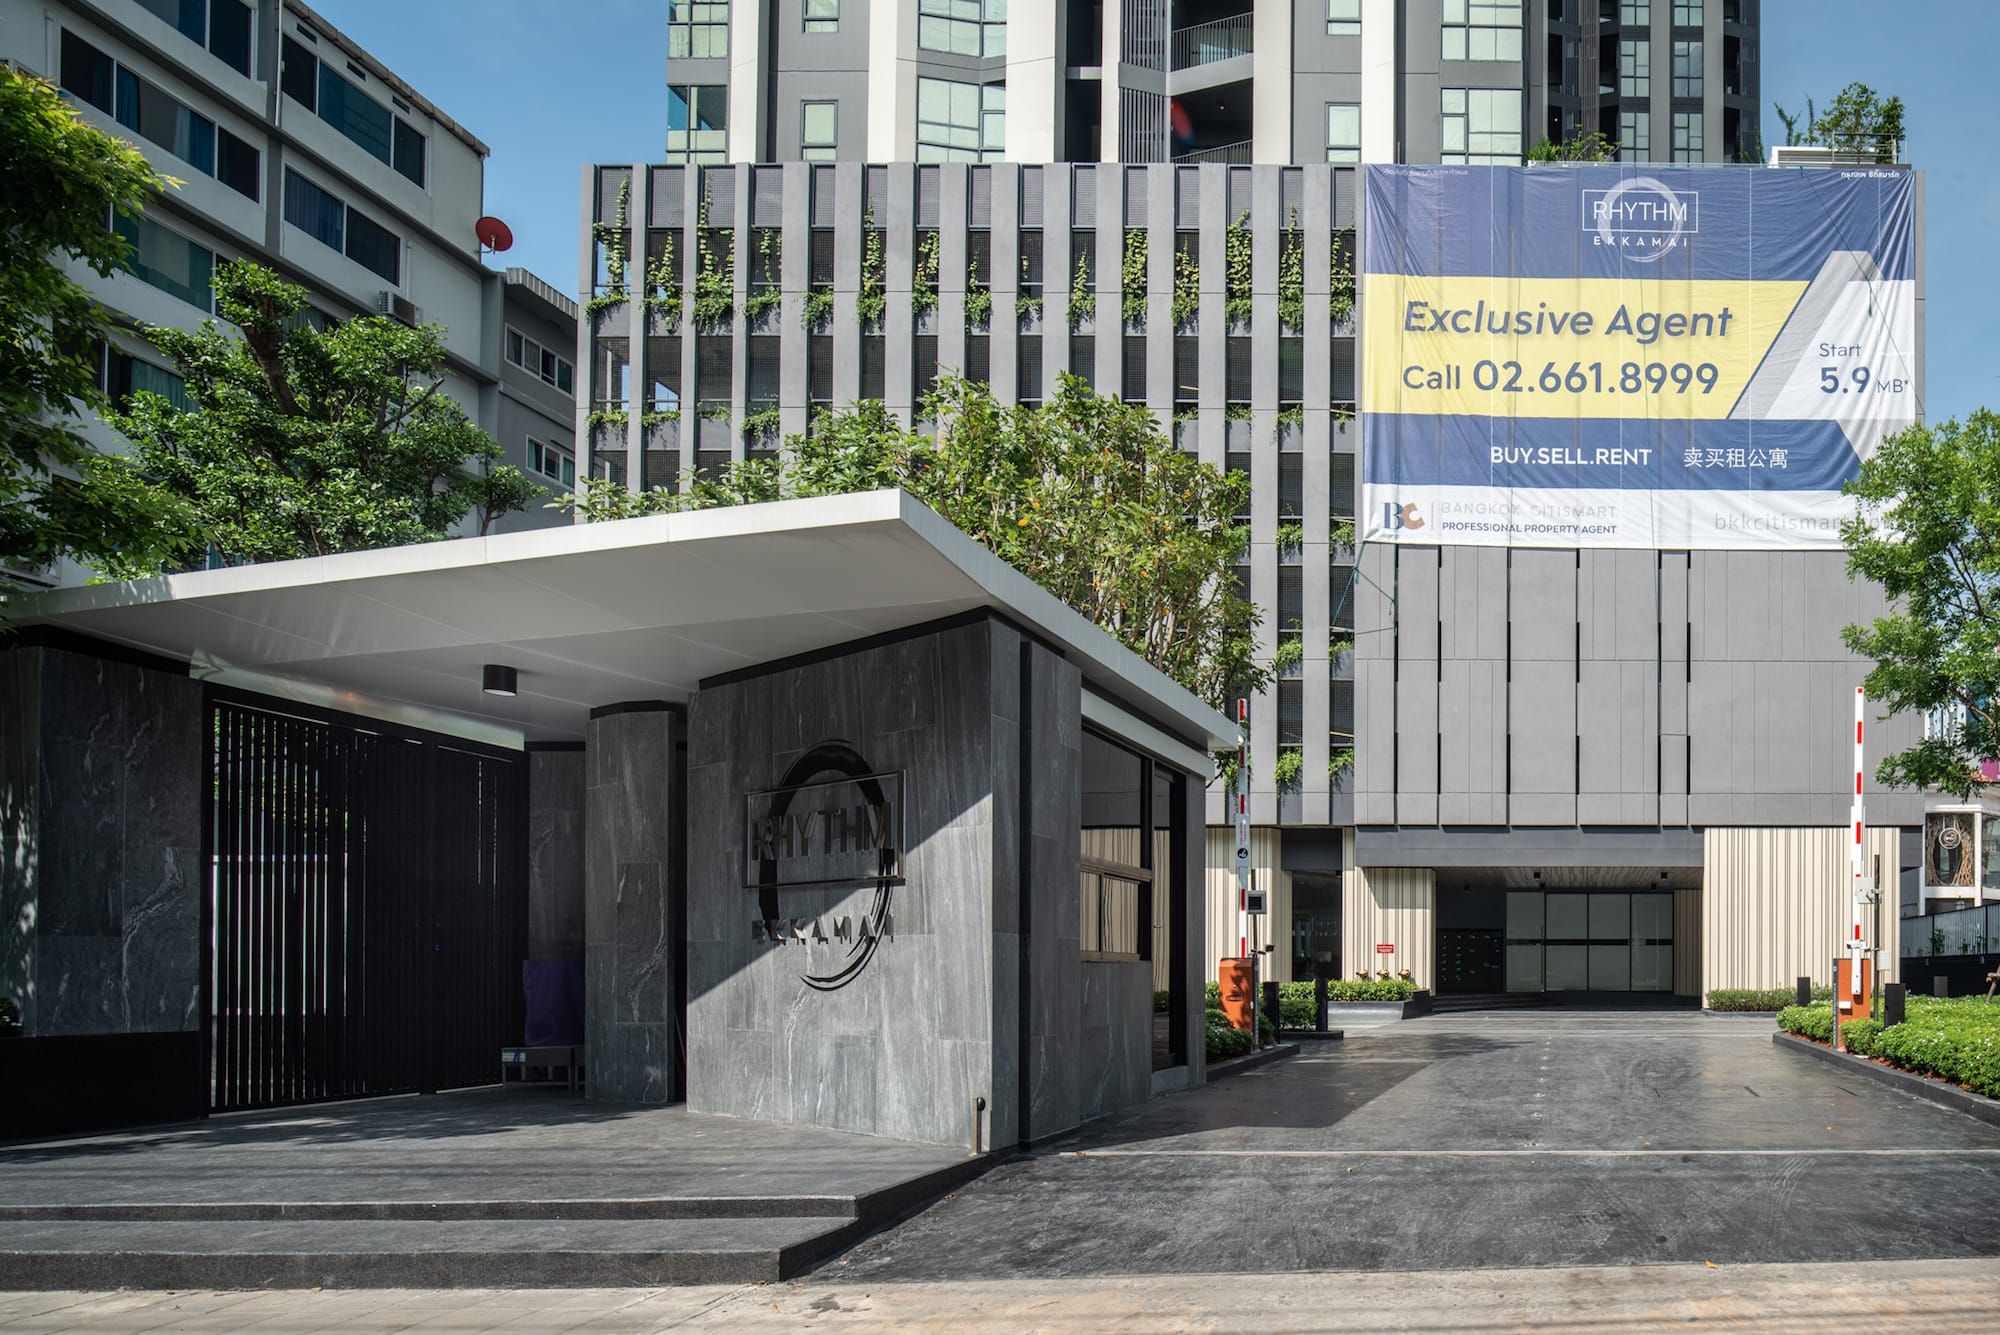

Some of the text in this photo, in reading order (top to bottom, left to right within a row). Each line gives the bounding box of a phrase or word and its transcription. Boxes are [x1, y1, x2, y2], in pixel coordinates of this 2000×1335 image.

[1593, 200, 1687, 221] RHYTHM
[1593, 235, 1687, 248] EKKAMAI
[1404, 300, 1733, 345] Exclusive Agent
[1819, 343, 1862, 357] Start
[1403, 360, 1719, 394] Call 02.661.8999
[1820, 366, 1871, 394] 5.9
[1490, 447, 1652, 466] BUY.SELL.RENT
[1683, 447, 1789, 469] 卖买租公寓
[1441, 503, 1521, 517] BANGKOK
[1442, 522, 1618, 535] PROFESSIONAL PROPERTY AGENT
[752, 802, 895, 861] RHYTHM
